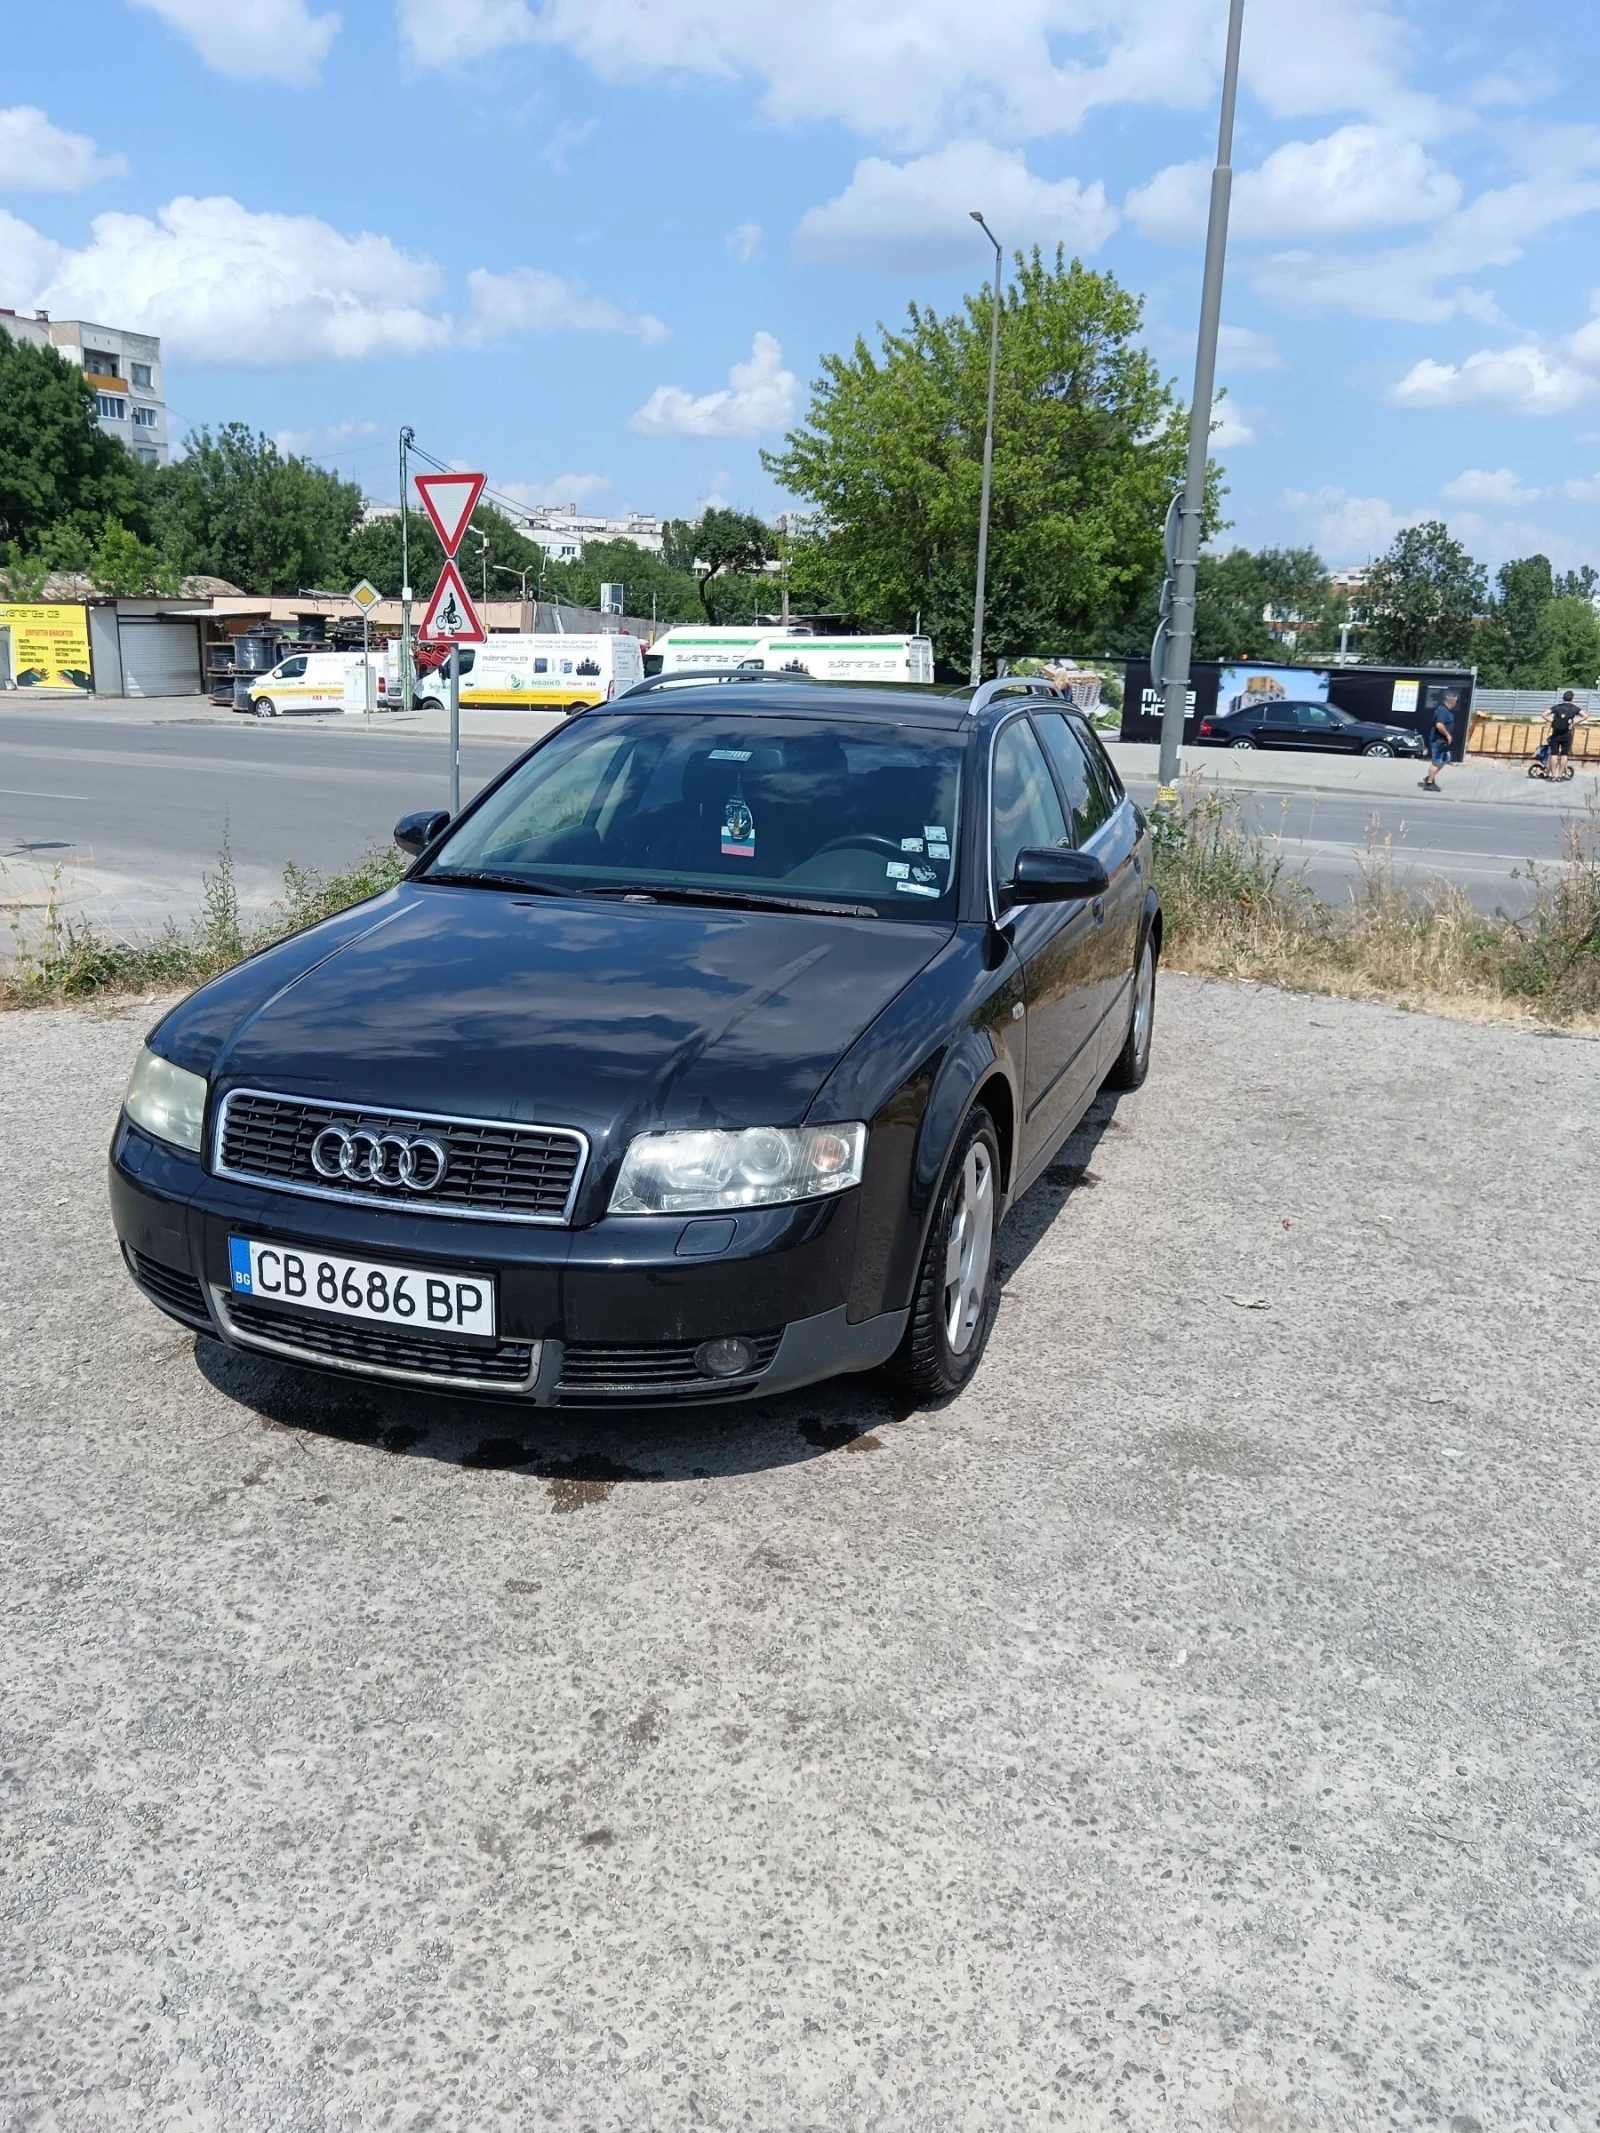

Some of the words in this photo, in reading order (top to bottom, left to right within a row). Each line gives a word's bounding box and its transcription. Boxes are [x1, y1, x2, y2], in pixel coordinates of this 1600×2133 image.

[1140, 703, 1196, 719] HOE
[234, 1270, 251, 1287] BG
[257, 1249, 308, 1298] CB
[316, 1261, 417, 1318] 8686
[425, 1278, 484, 1326] BP
